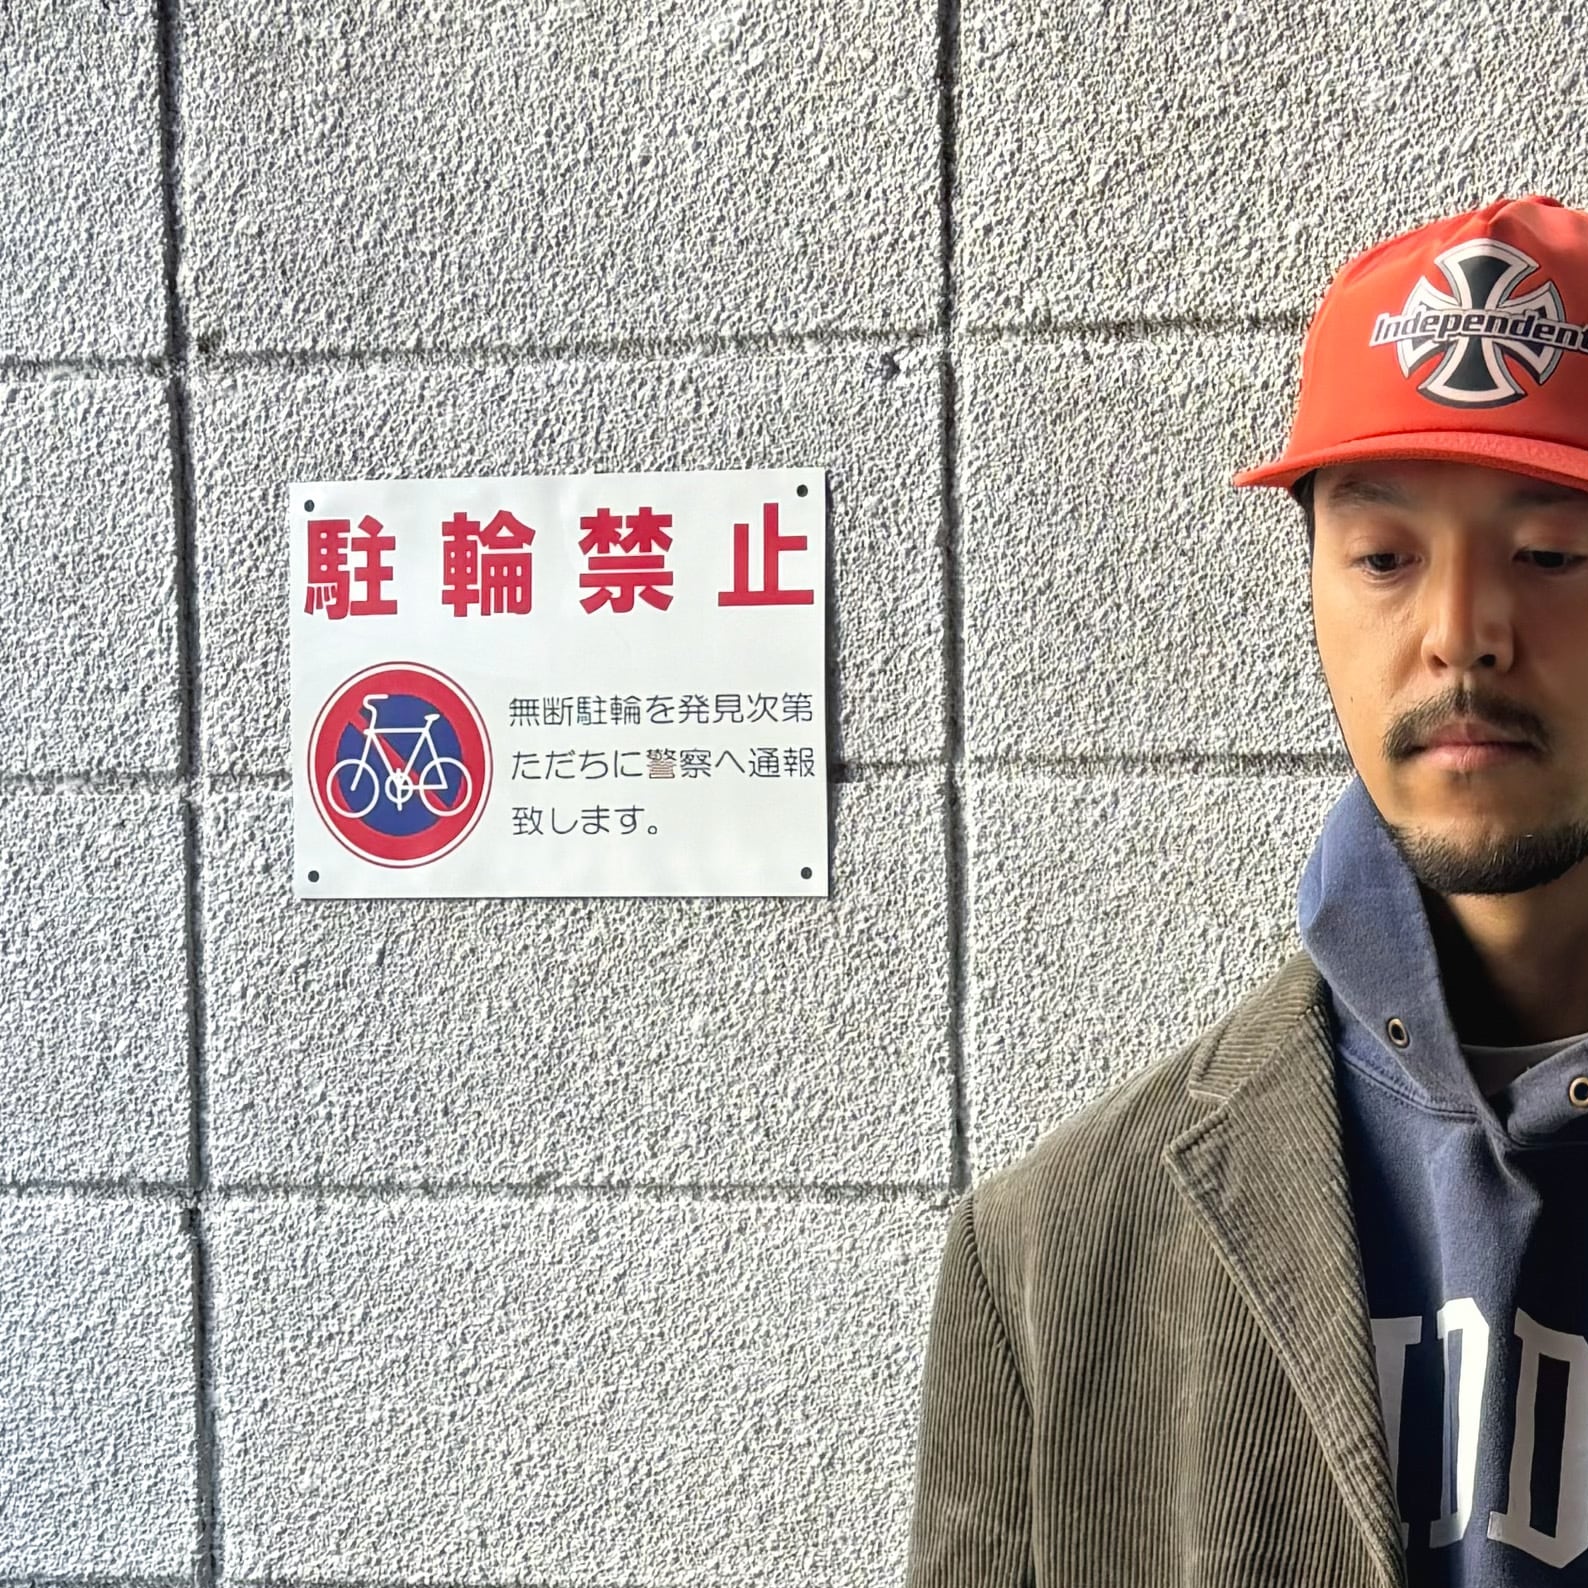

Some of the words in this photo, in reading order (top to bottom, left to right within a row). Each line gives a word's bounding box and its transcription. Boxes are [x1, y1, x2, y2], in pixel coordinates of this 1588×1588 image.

[304, 502, 815, 620] 駐輪禁止
[508, 692, 814, 727] 無断駐輪を発見次第
[511, 747, 816, 780] ただちに警察へ通報
[511, 805, 659, 836] 致します。
